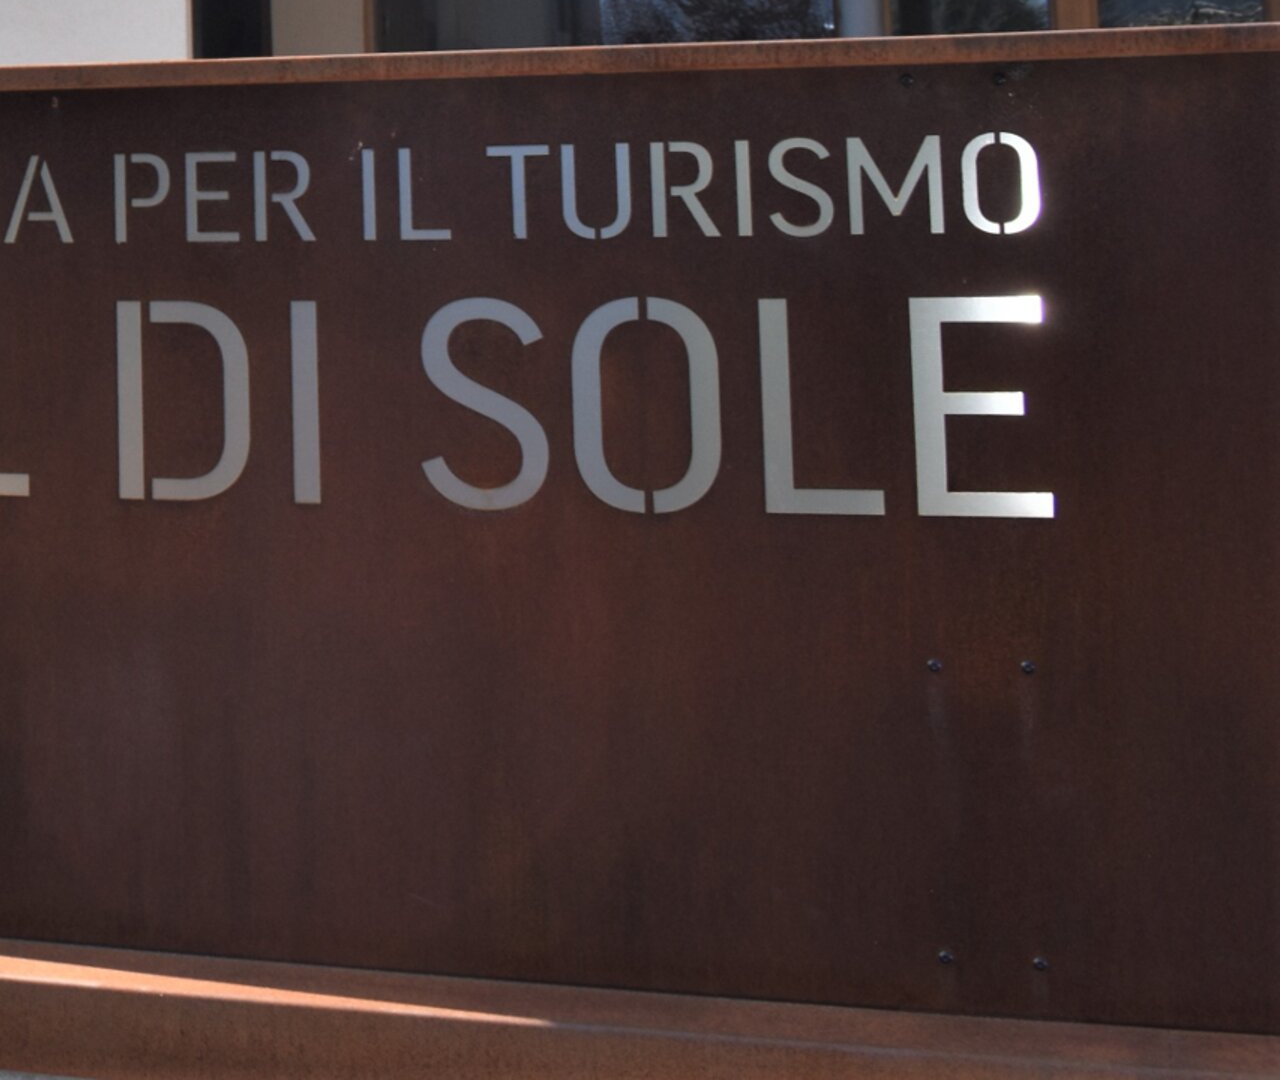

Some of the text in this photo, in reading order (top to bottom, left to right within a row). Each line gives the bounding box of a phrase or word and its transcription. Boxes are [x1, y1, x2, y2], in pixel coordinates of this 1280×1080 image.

[114, 150, 316, 244] PER
[360, 147, 452, 241] IL
[486, 131, 1047, 240] TURISMO
[116, 300, 322, 504] DI
[420, 289, 1056, 518] SOLE
